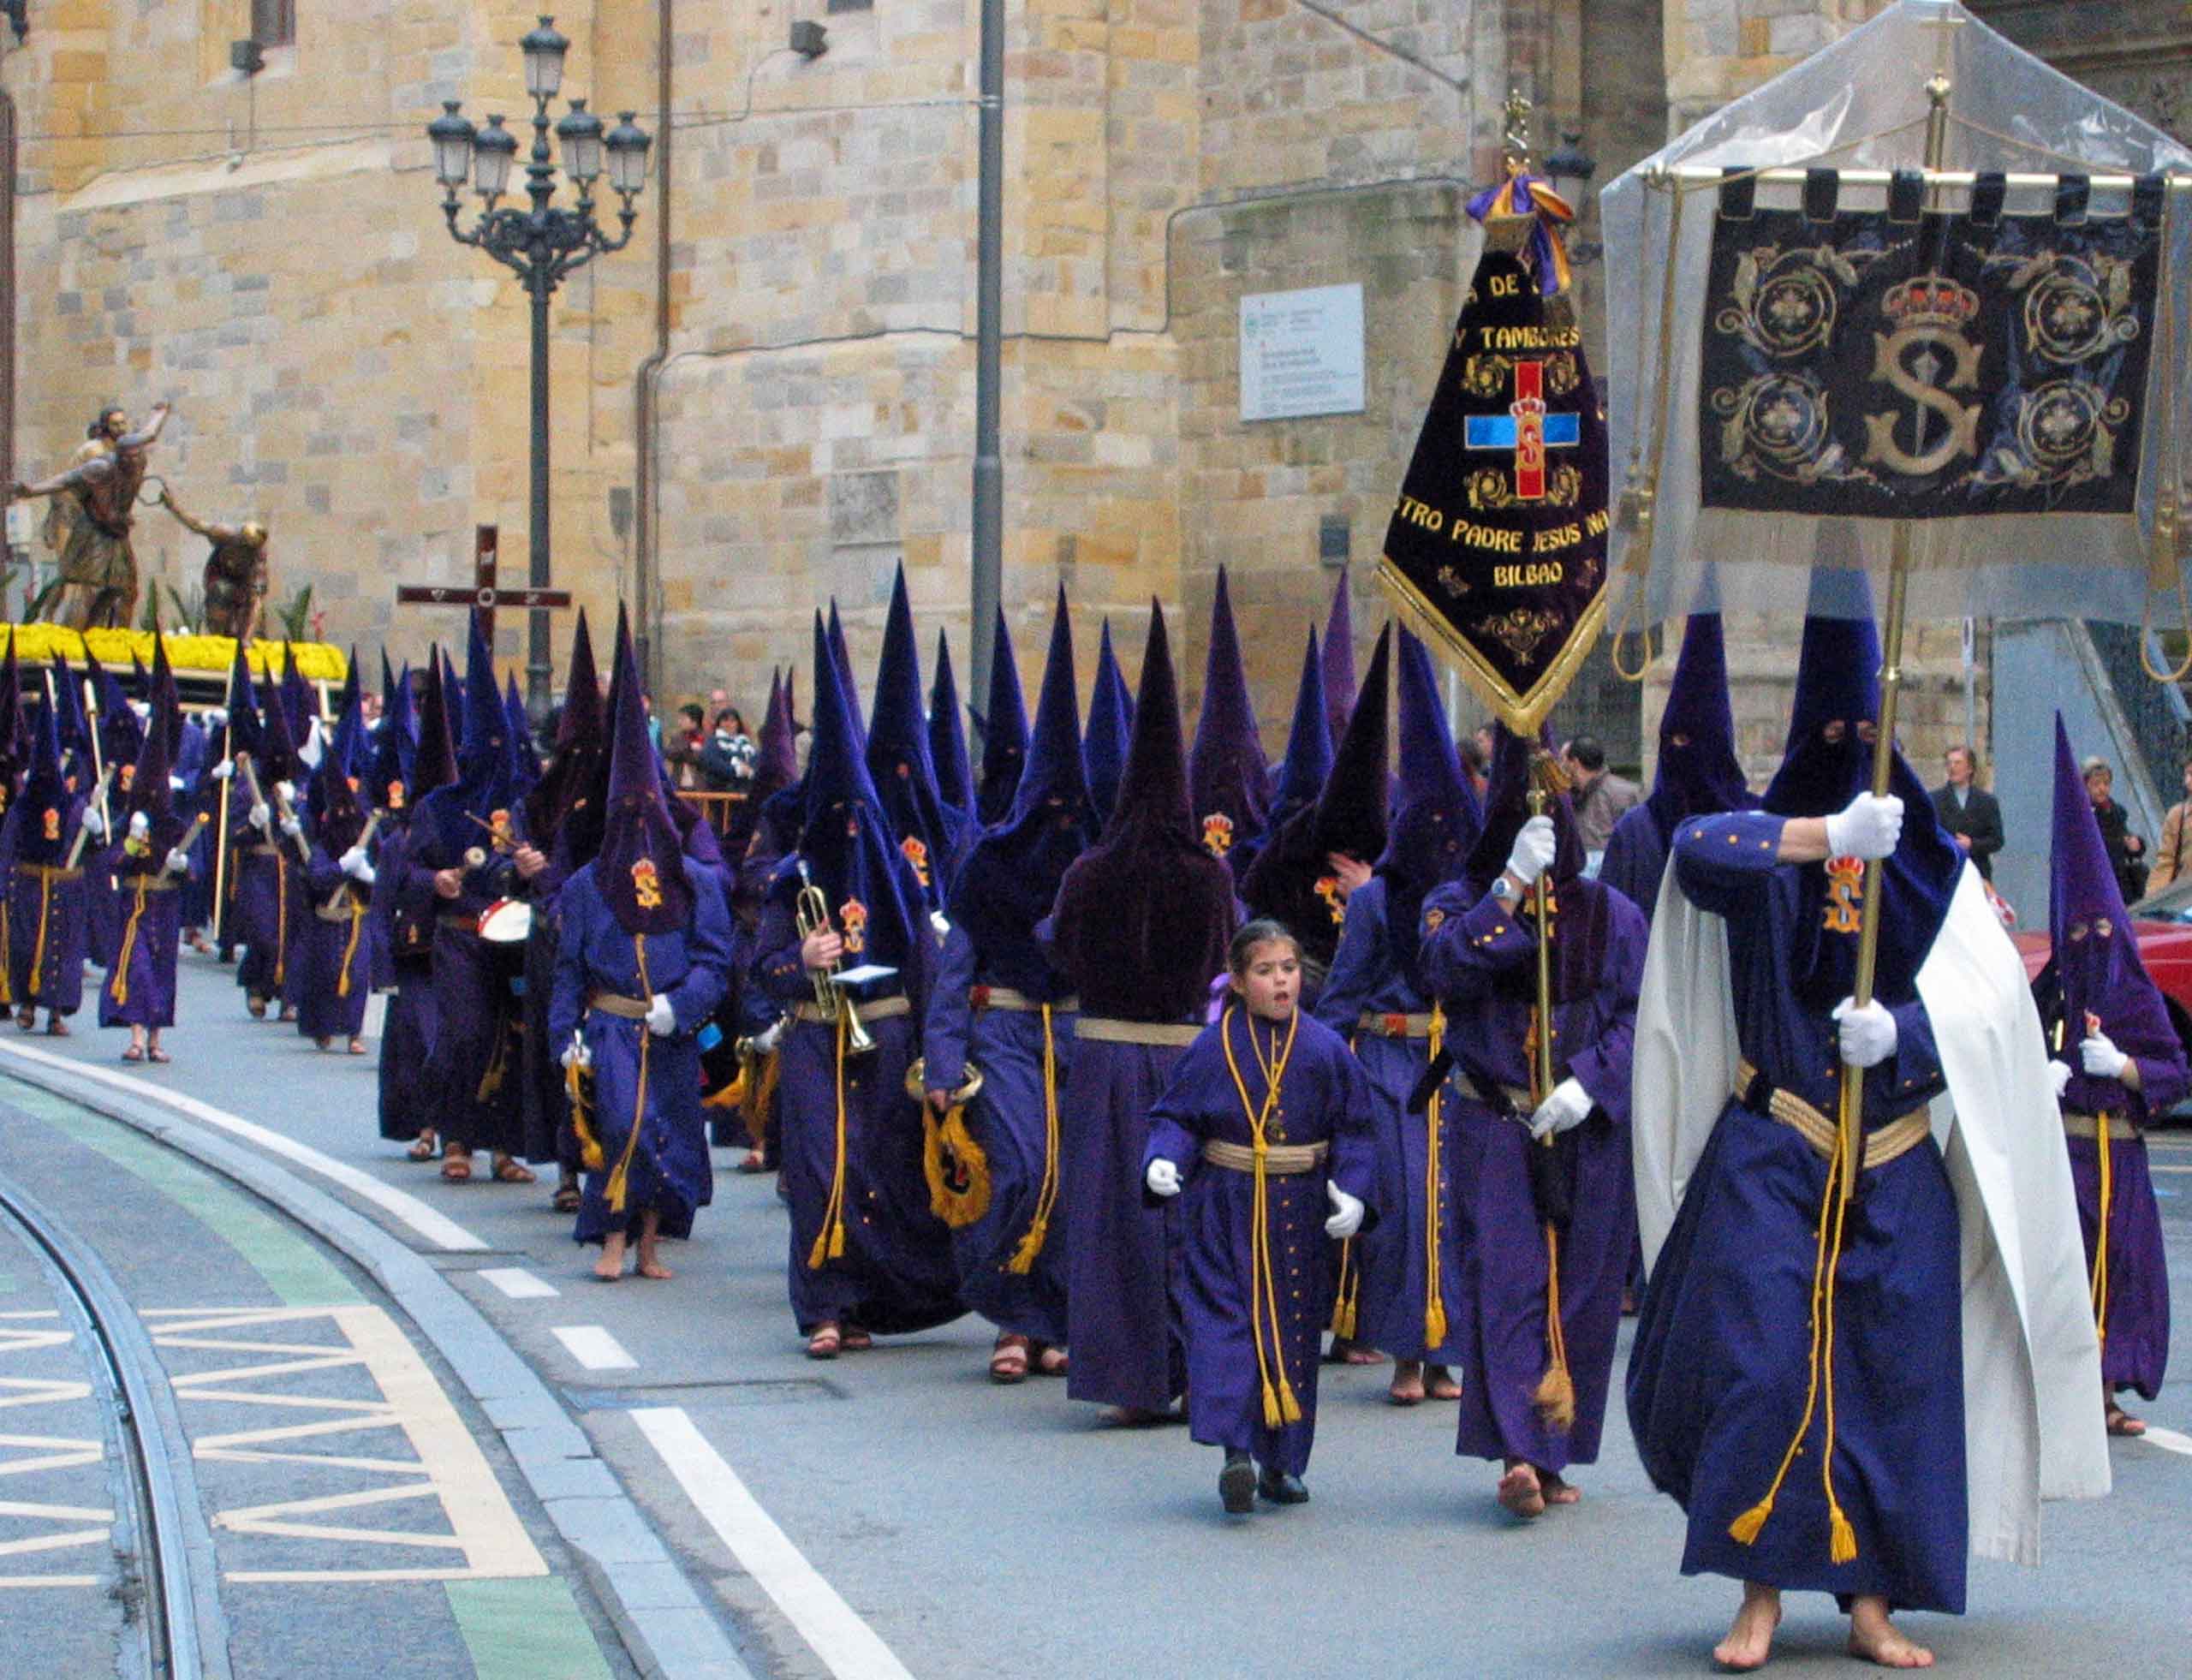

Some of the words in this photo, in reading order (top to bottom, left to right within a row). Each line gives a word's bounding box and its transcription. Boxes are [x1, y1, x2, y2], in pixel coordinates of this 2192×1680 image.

[1490, 273, 1520, 296] DE
[1451, 519, 1523, 552] PADRE
[1533, 522, 1581, 553] JESUS
[1493, 561, 1564, 587] BILBAO
